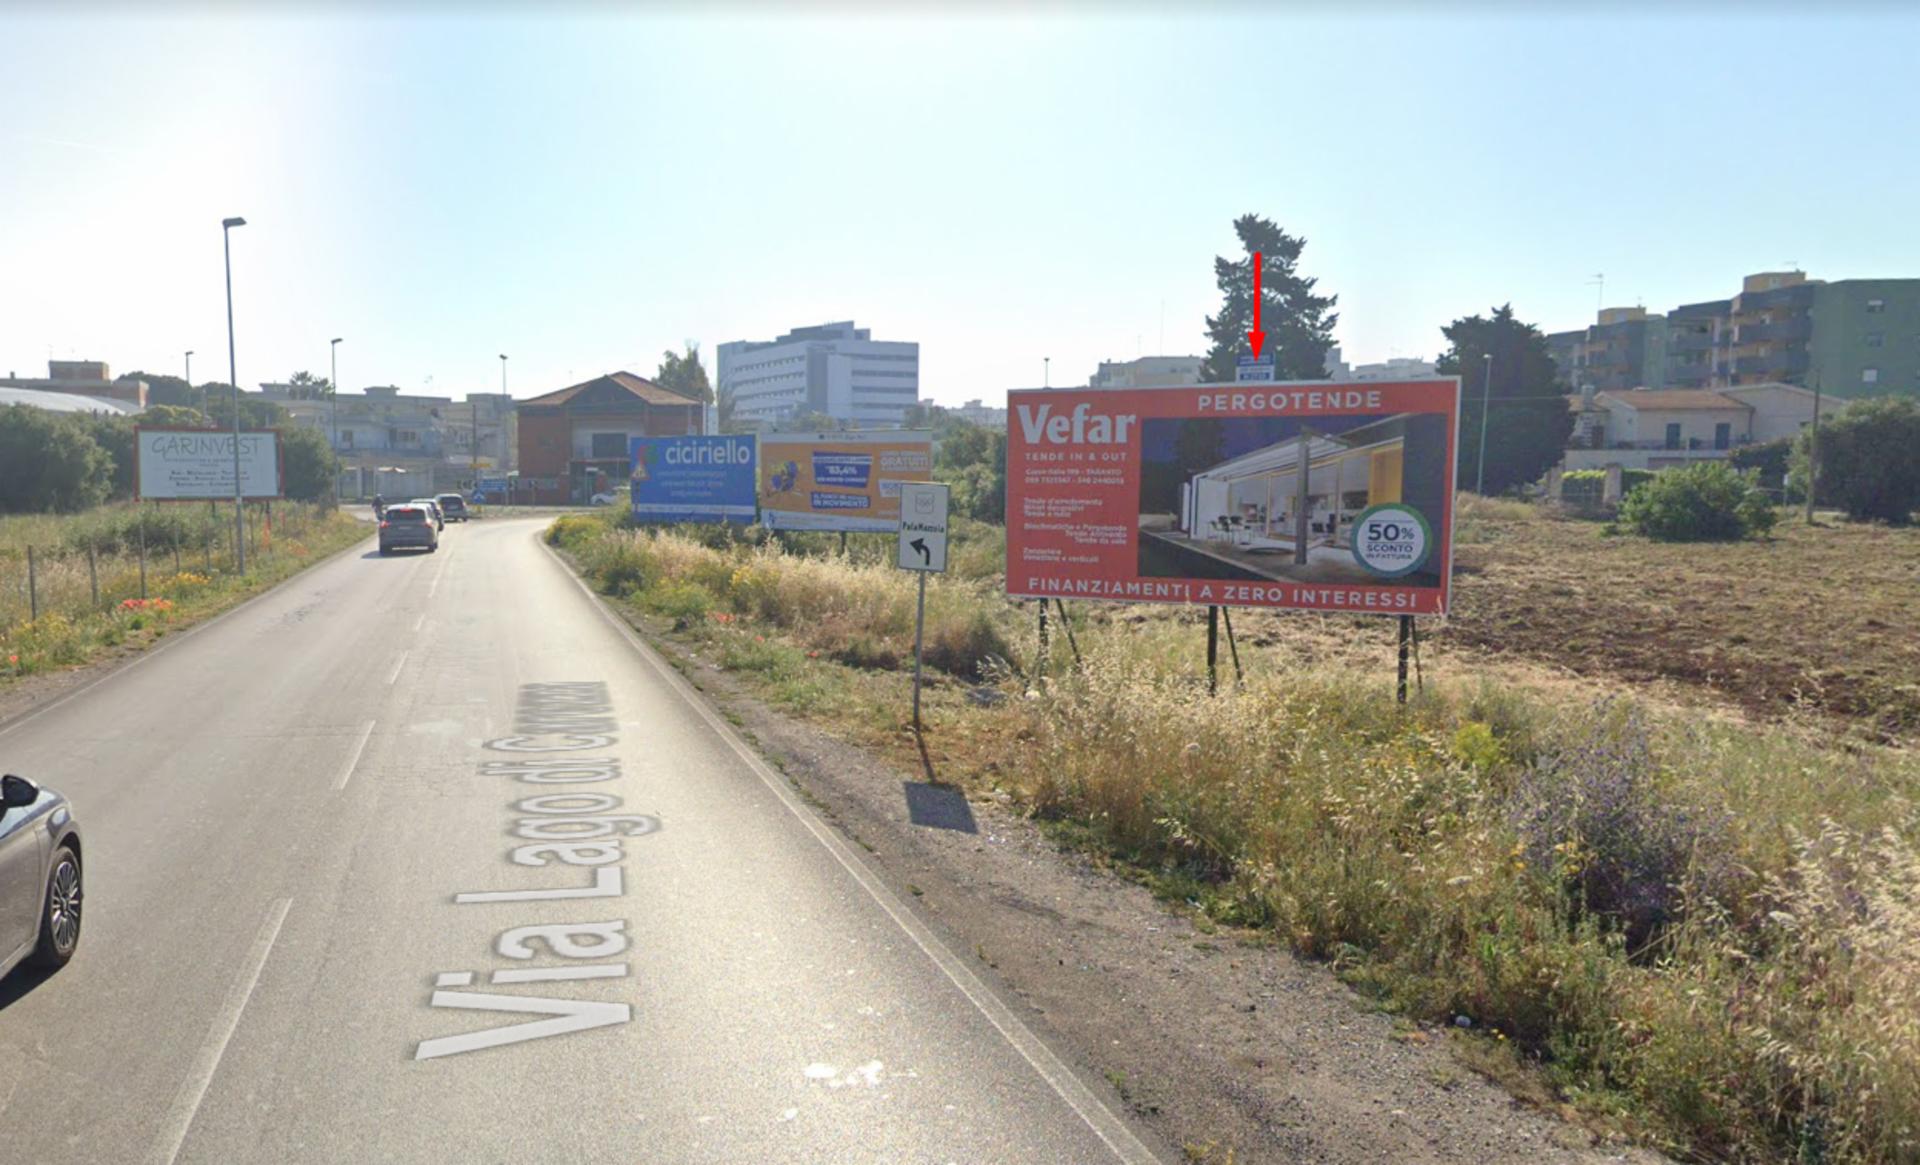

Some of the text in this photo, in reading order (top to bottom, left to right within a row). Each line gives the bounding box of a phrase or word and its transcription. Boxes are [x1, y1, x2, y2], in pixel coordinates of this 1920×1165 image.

[1197, 391, 1383, 411] PERGOTENDE
[1016, 403, 1136, 444] Vefar
[151, 435, 262, 459] GARINVEST
[665, 439, 750, 464] ciciriello
[1025, 452, 1064, 461] TENDE
[1071, 452, 1083, 461] IN
[1102, 453, 1128, 462] OUT
[1367, 544, 1413, 552] SCONTO
[1029, 577, 1417, 608] FINANZIAMENTI A ZERO INTERESSI
